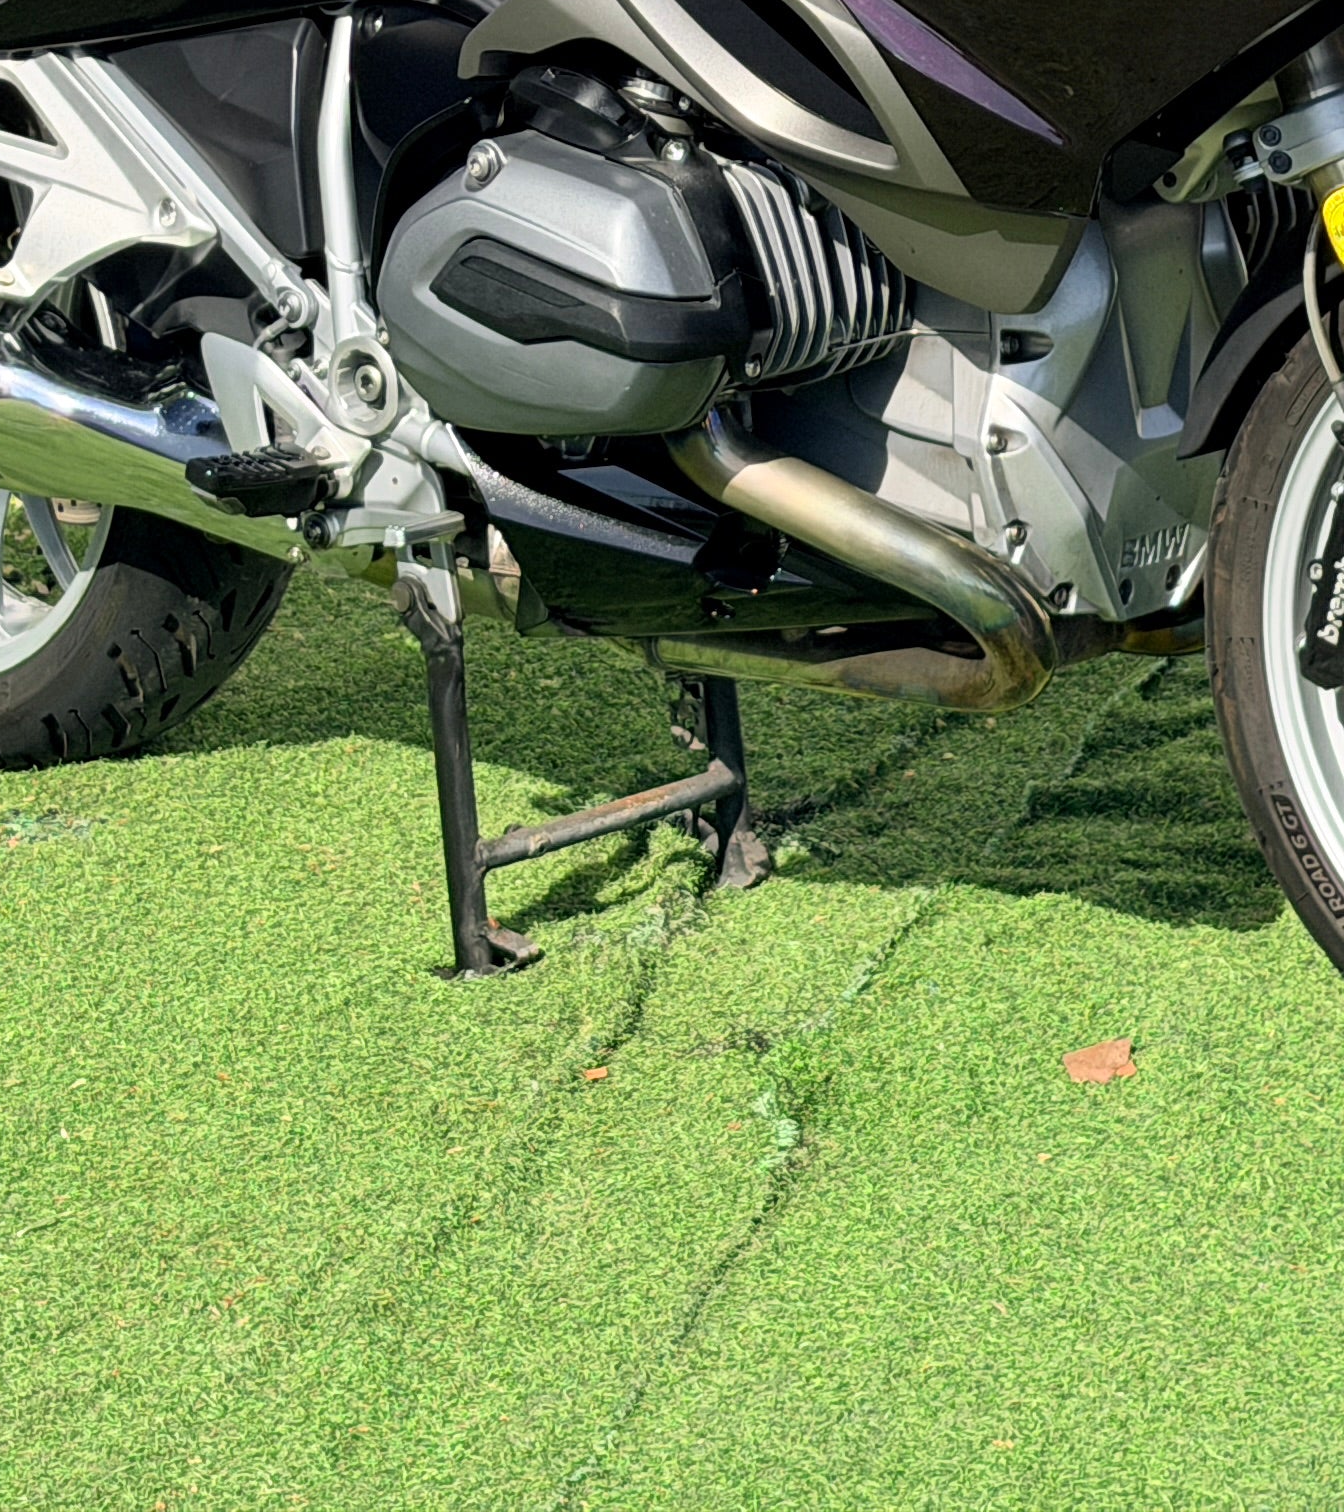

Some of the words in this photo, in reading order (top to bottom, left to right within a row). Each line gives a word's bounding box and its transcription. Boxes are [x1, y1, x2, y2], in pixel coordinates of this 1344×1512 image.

[1121, 523, 1191, 569] BMW
[1275, 800, 1300, 828] GT
[1292, 835, 1308, 850] 6
